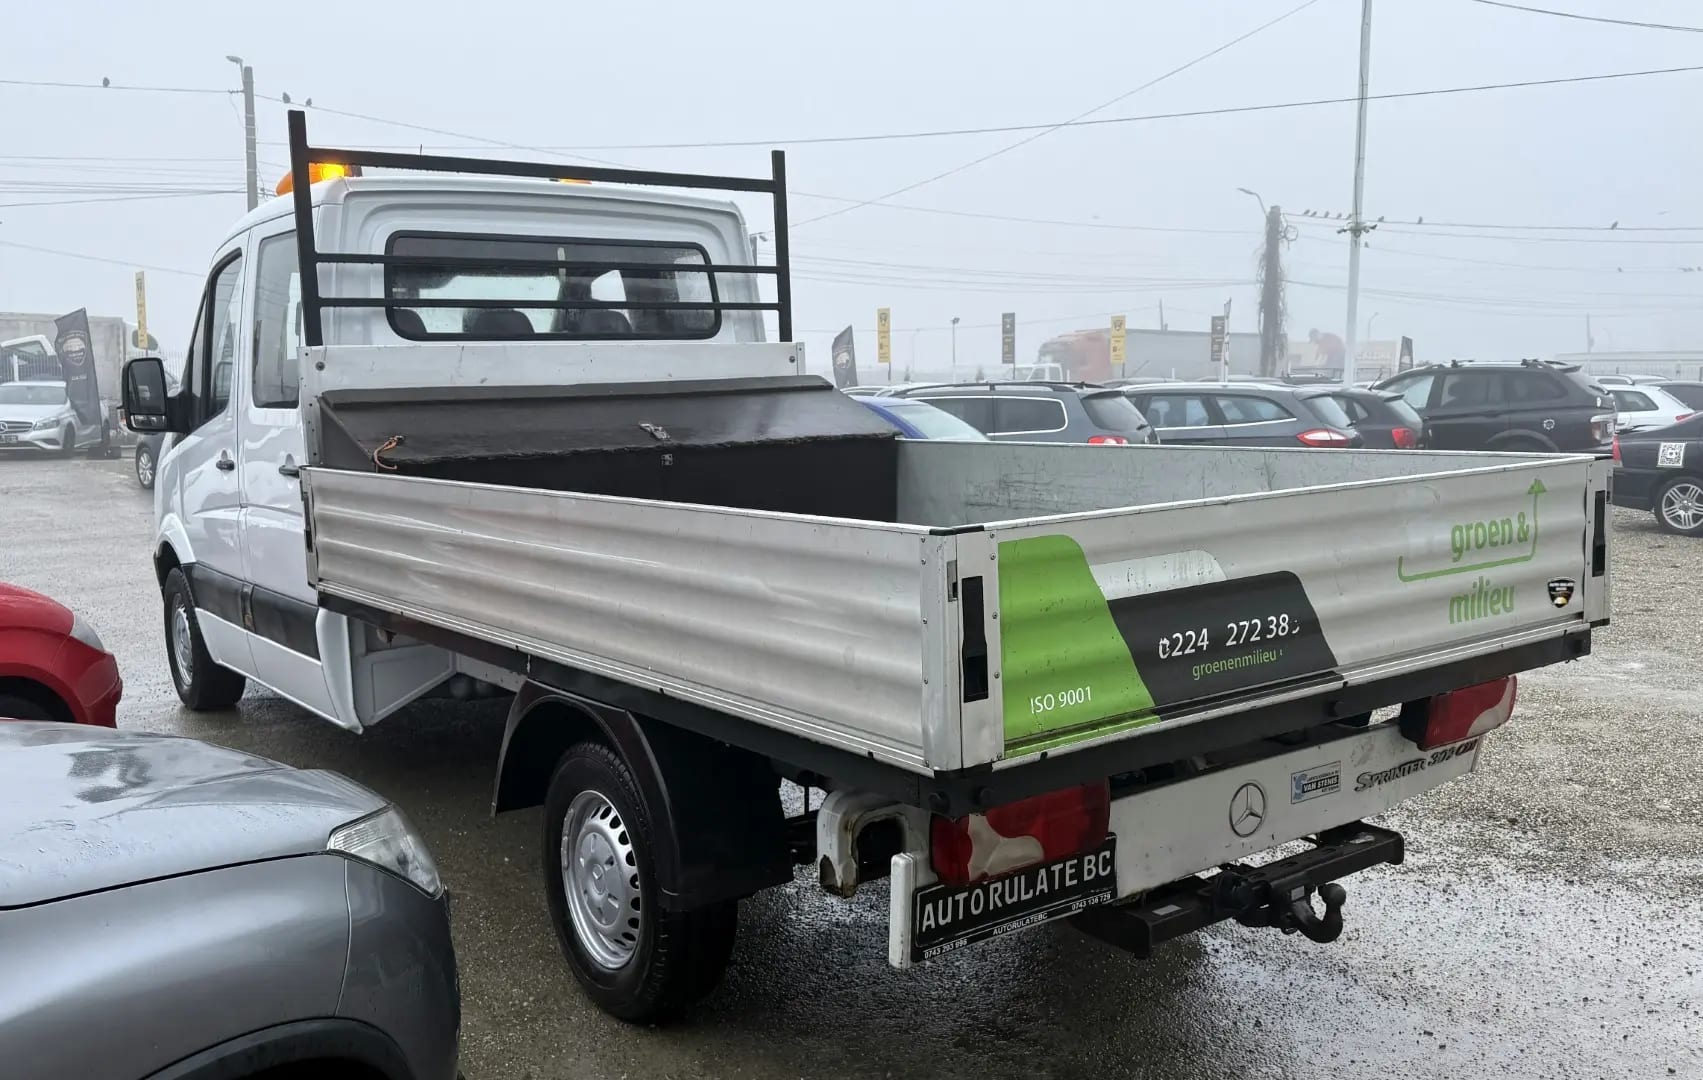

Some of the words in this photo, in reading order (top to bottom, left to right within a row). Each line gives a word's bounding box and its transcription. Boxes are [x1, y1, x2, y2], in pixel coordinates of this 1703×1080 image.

[1450, 516, 1514, 563] groen
[1517, 511, 1530, 544] &
[1449, 575, 1516, 624] milieu
[1225, 618, 1262, 647] 272
[1030, 693, 1055, 714] ISO
[1058, 685, 1092, 708] 9001
[1083, 850, 1112, 881] BC
[1071, 900, 1087, 911] 0743
[924, 948, 941, 959] 0743
